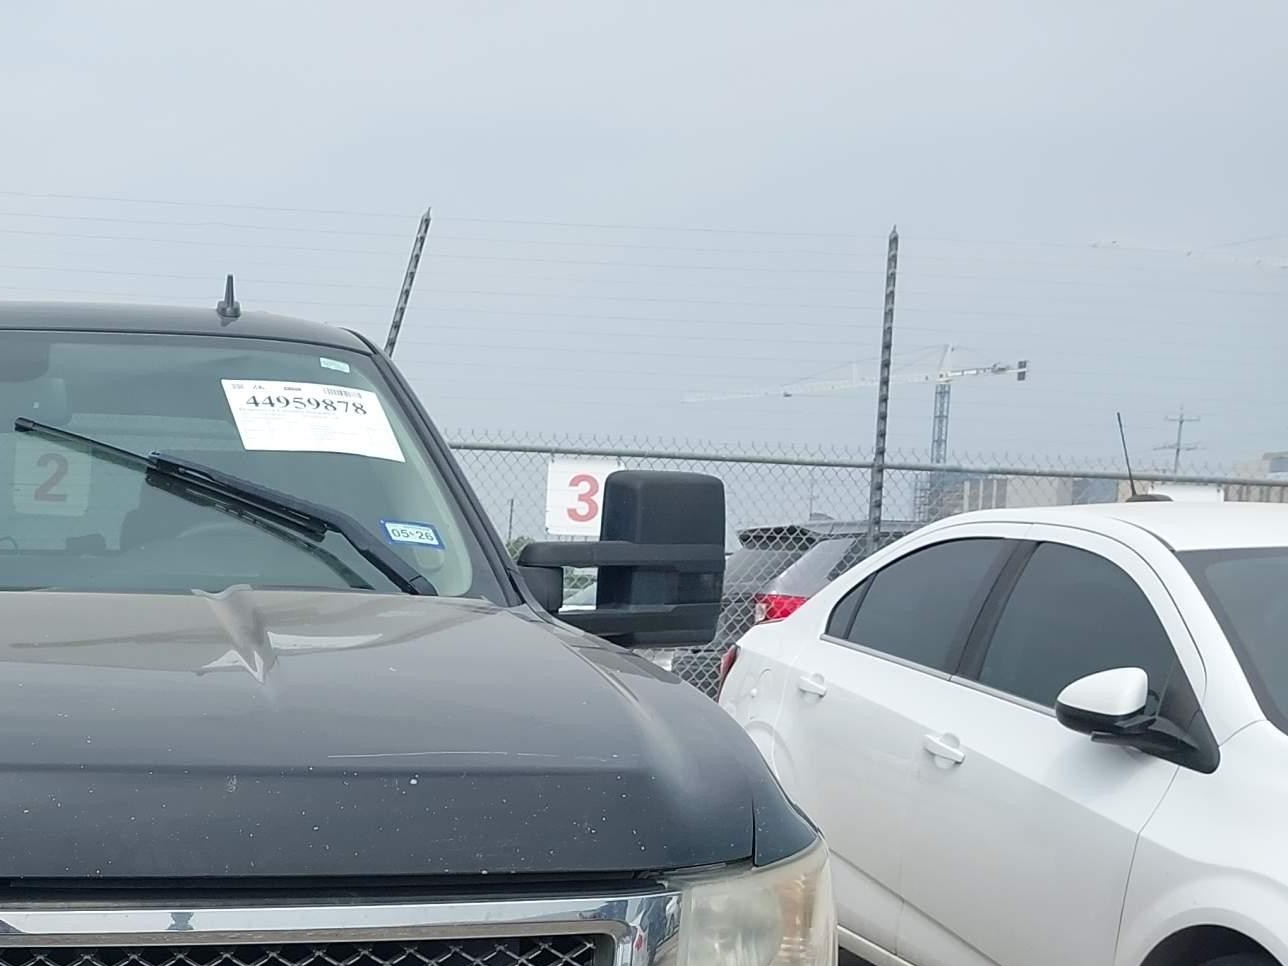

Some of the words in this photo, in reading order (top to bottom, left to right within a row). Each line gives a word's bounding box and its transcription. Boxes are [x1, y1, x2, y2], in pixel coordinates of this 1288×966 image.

[245, 394, 368, 416] 44959878
[34, 453, 69, 502] 2
[567, 474, 600, 523] 3
